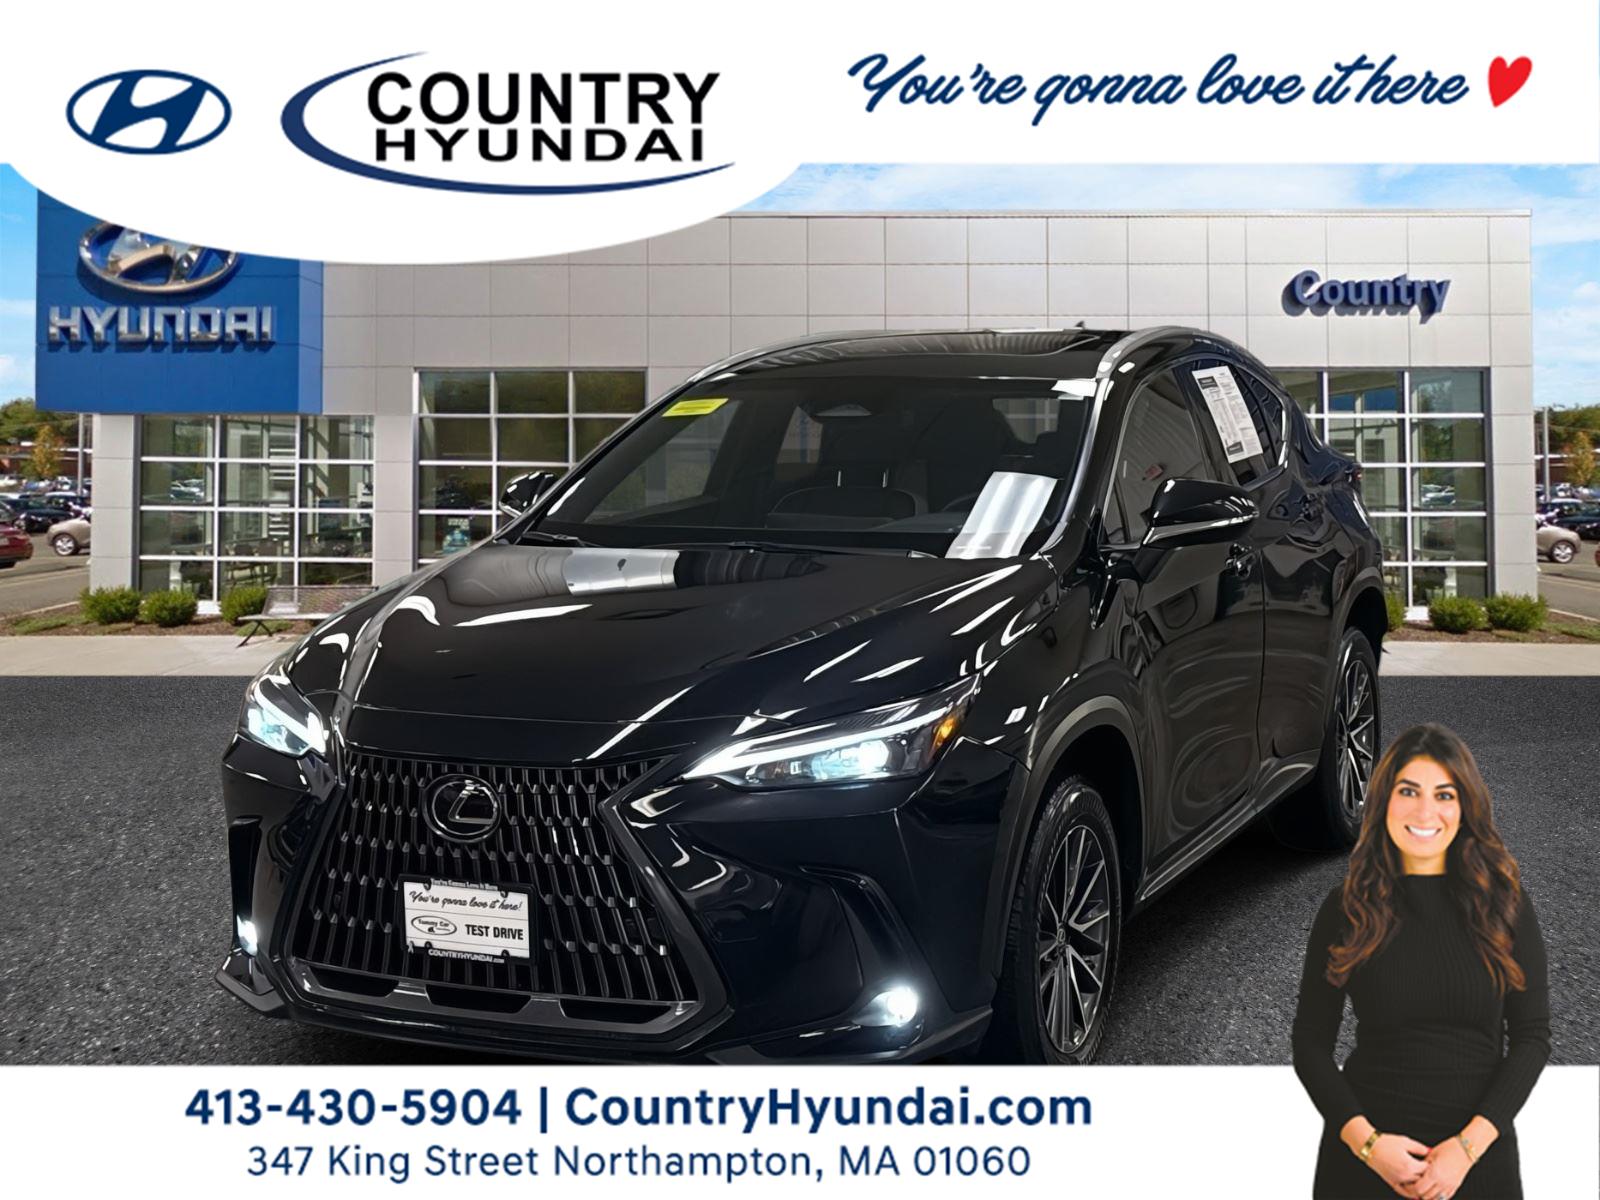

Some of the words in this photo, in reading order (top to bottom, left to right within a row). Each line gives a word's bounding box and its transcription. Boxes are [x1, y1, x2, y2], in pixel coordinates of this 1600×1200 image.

[1284, 270, 1452, 321] Country
[49, 306, 274, 344] HYUNDAI
[465, 924, 490, 937] TEST
[493, 927, 524, 940] DRIVE
